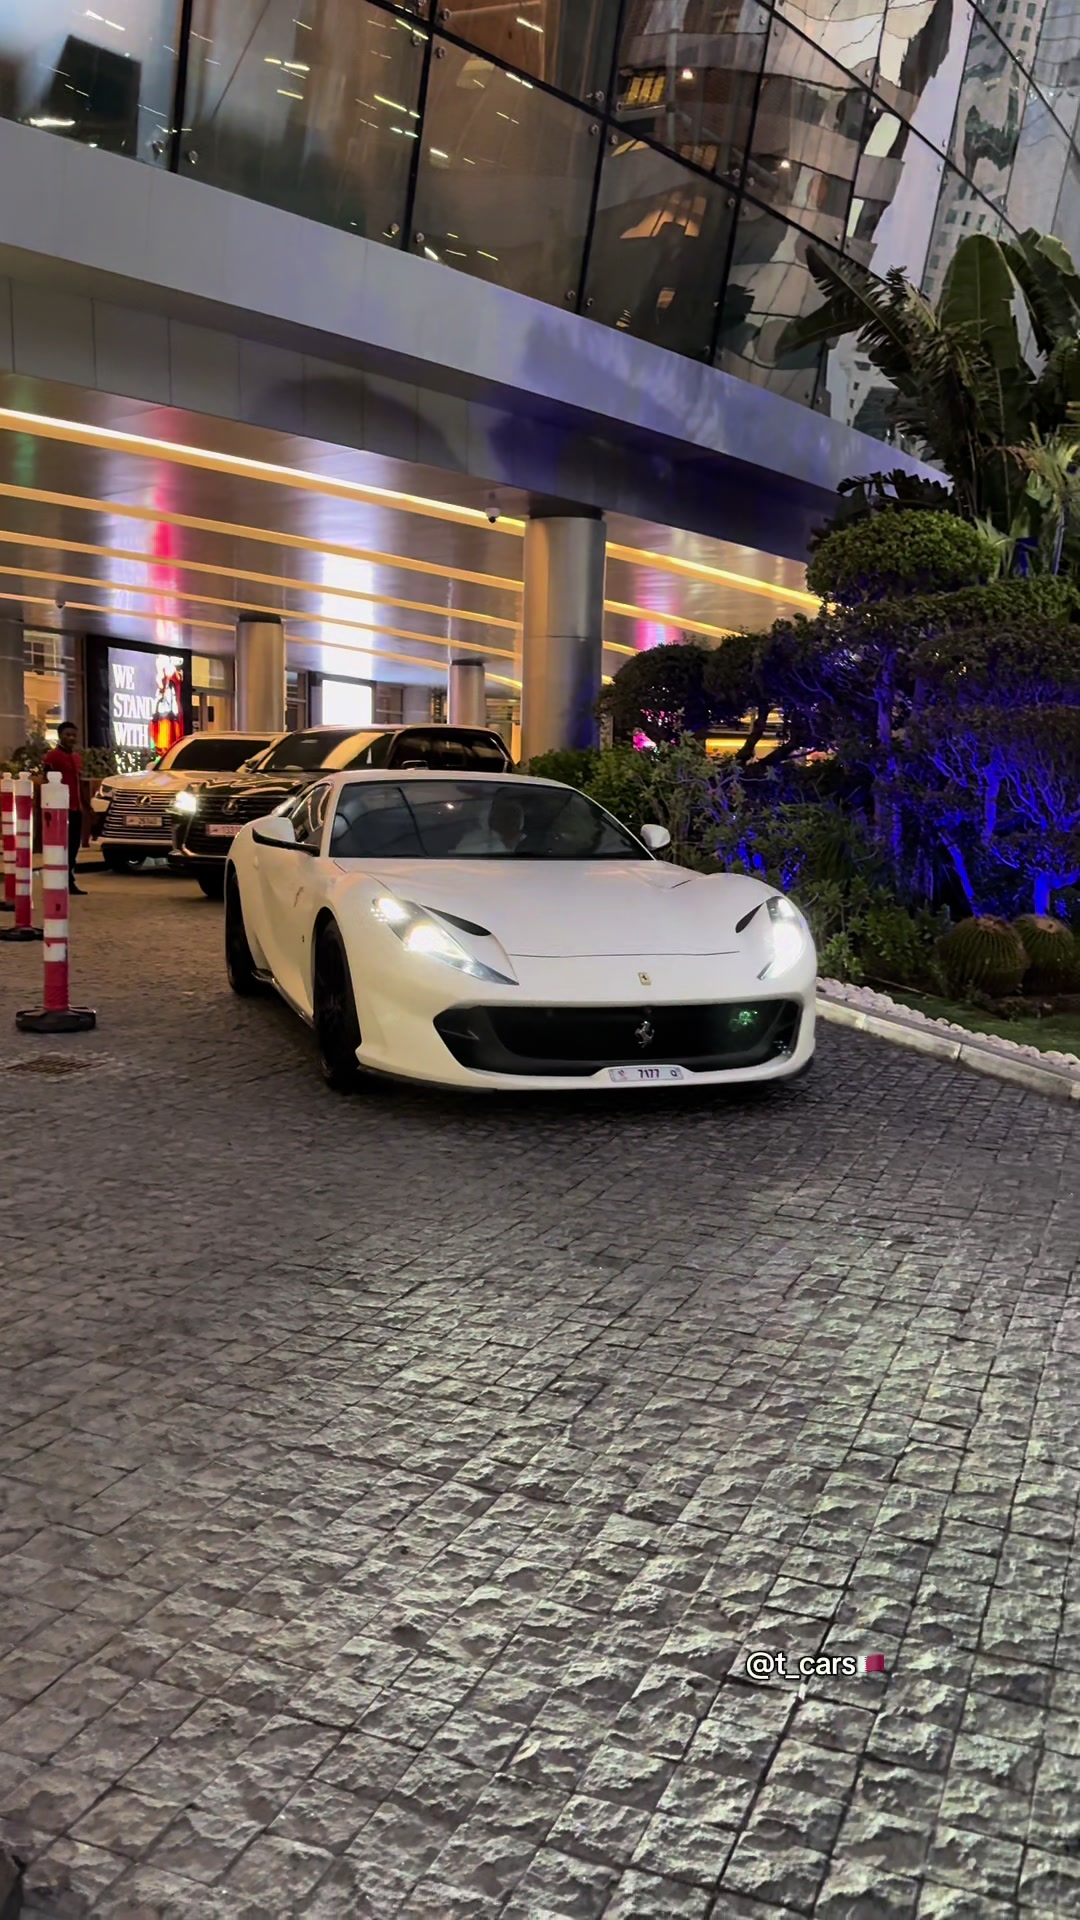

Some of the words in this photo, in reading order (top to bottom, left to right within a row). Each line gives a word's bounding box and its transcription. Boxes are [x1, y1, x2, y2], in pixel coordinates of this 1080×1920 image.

[112, 663, 135, 690] WE
[113, 692, 155, 720] STAND
[112, 721, 149, 748] WITH
[637, 1068, 660, 1079] 7177
